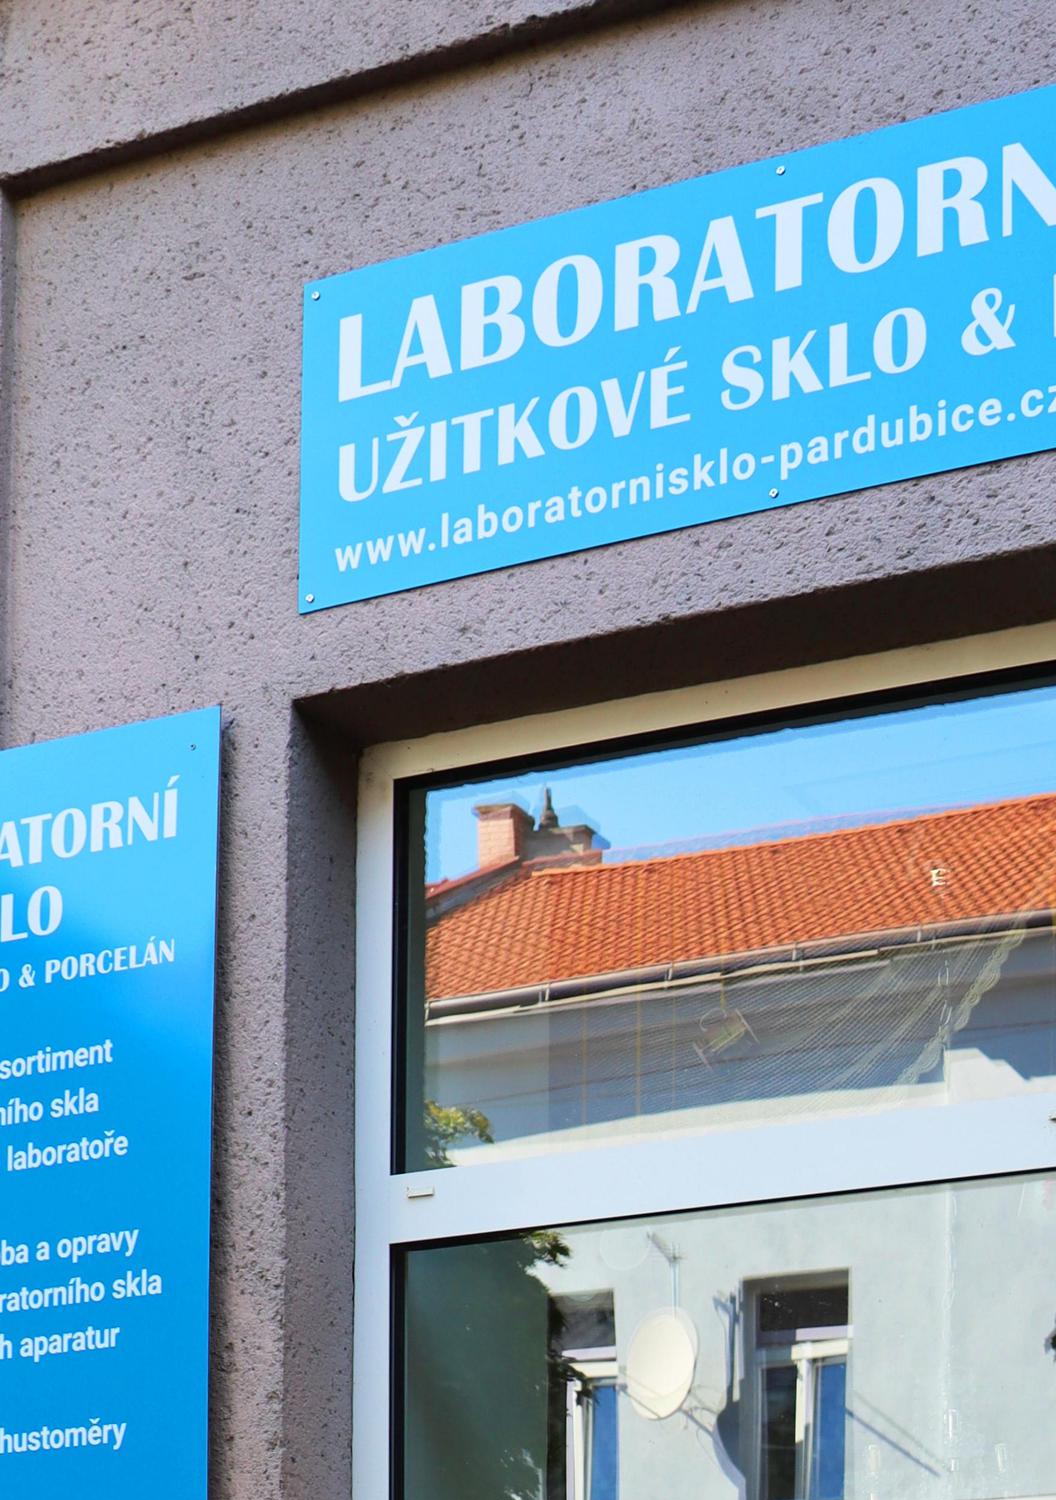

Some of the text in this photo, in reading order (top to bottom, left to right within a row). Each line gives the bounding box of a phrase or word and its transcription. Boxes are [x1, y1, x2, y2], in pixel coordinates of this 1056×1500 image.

[338, 346, 690, 503] UŽITKOVÉ
[721, 307, 927, 411] SKLO
[961, 287, 1016, 357] &
[0, 774, 180, 868] ATORNÍ
[18, 962, 36, 989] &
[45, 935, 176, 984] PORCELÁN
[0, 1038, 113, 1079] sortiment
[50, 1089, 99, 1118] skla
[7, 1131, 129, 1172] laboratoře
[36, 1243, 50, 1259] a
[57, 1228, 139, 1263] opravy
[112, 1270, 162, 1300] skla
[20, 1324, 120, 1362] aparatur
[0, 1417, 127, 1455] hustoměry
